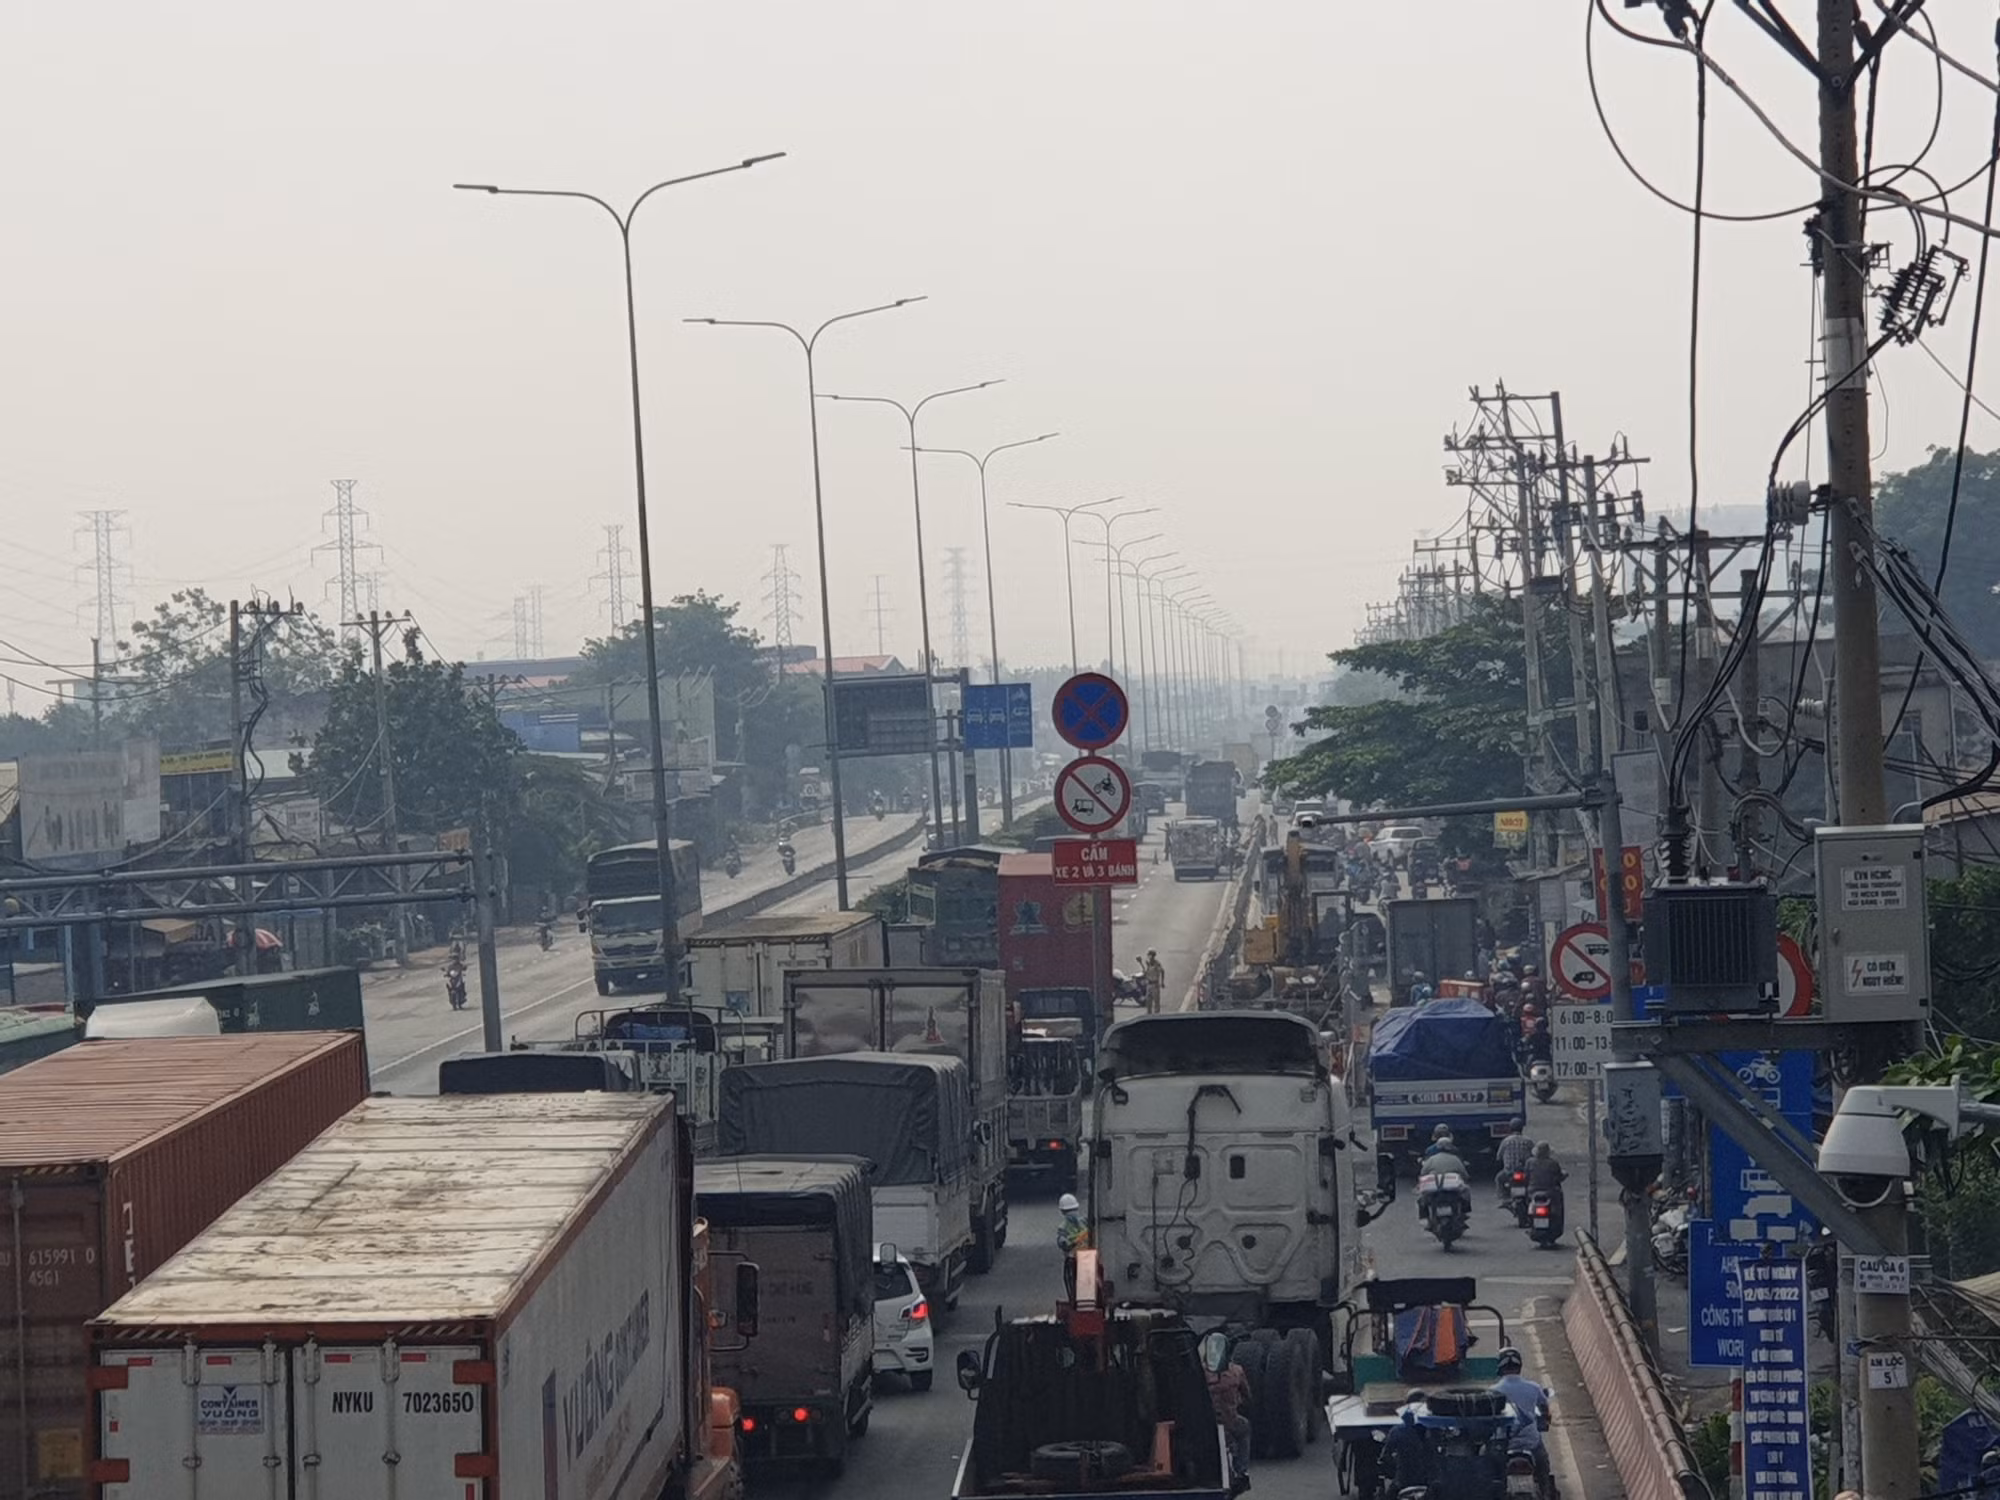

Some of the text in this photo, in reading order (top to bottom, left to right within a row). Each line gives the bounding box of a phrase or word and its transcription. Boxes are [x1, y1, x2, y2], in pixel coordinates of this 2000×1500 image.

[1081, 842, 1108, 861] CẤM
[1056, 866, 1069, 879] XE
[1072, 866, 1080, 879] 2
[1097, 865, 1105, 878] 3
[1107, 862, 1135, 878] BÁNH
[1560, 1010, 1613, 1025] 6:00-8:0
[1556, 1036, 1612, 1051] 11:00-13:
[1557, 1062, 1601, 1077] 17:00-1
[29, 1248, 75, 1266] 615991
[86, 1247, 95, 1264] 0
[1717, 1339, 1744, 1357] WOR
[1884, 1371, 1892, 1385] 5
[332, 1391, 474, 1414] NYKU 7023650
